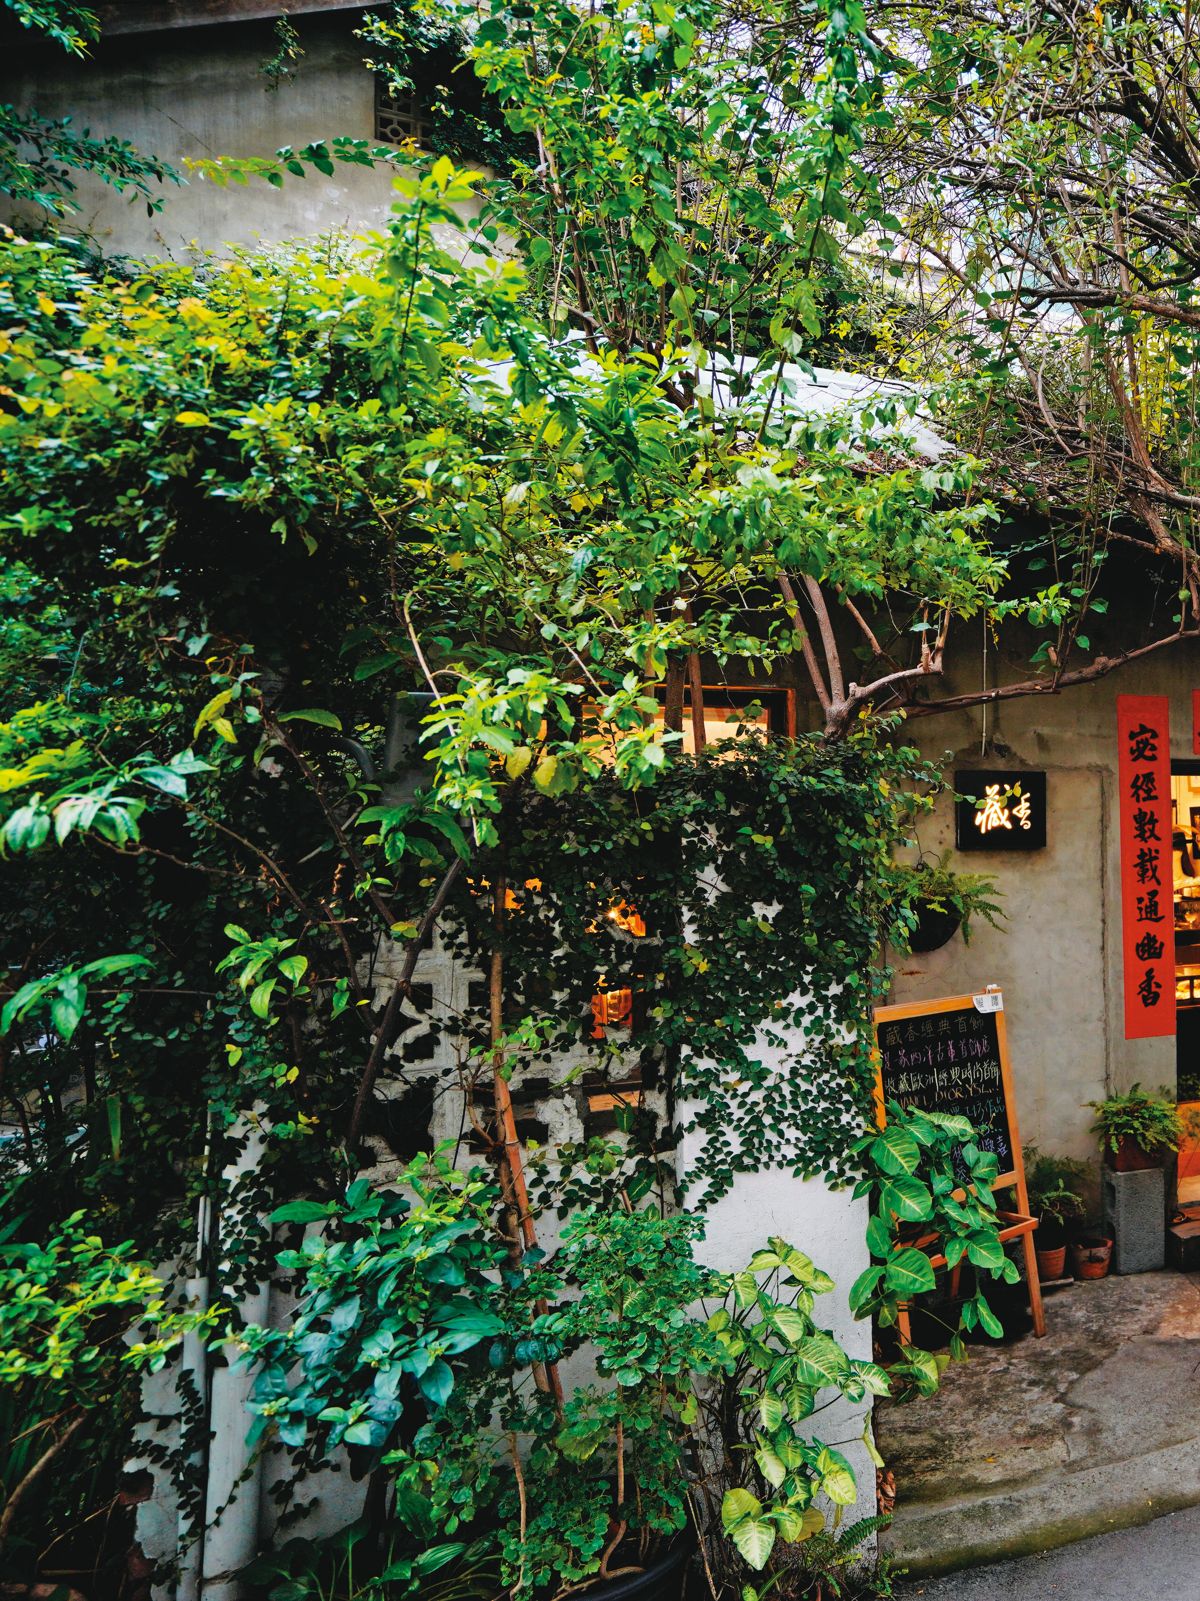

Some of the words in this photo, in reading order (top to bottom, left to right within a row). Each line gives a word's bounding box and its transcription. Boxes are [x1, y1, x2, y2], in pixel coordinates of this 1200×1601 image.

[885, 1015, 985, 1046] 藏香經典首飾
